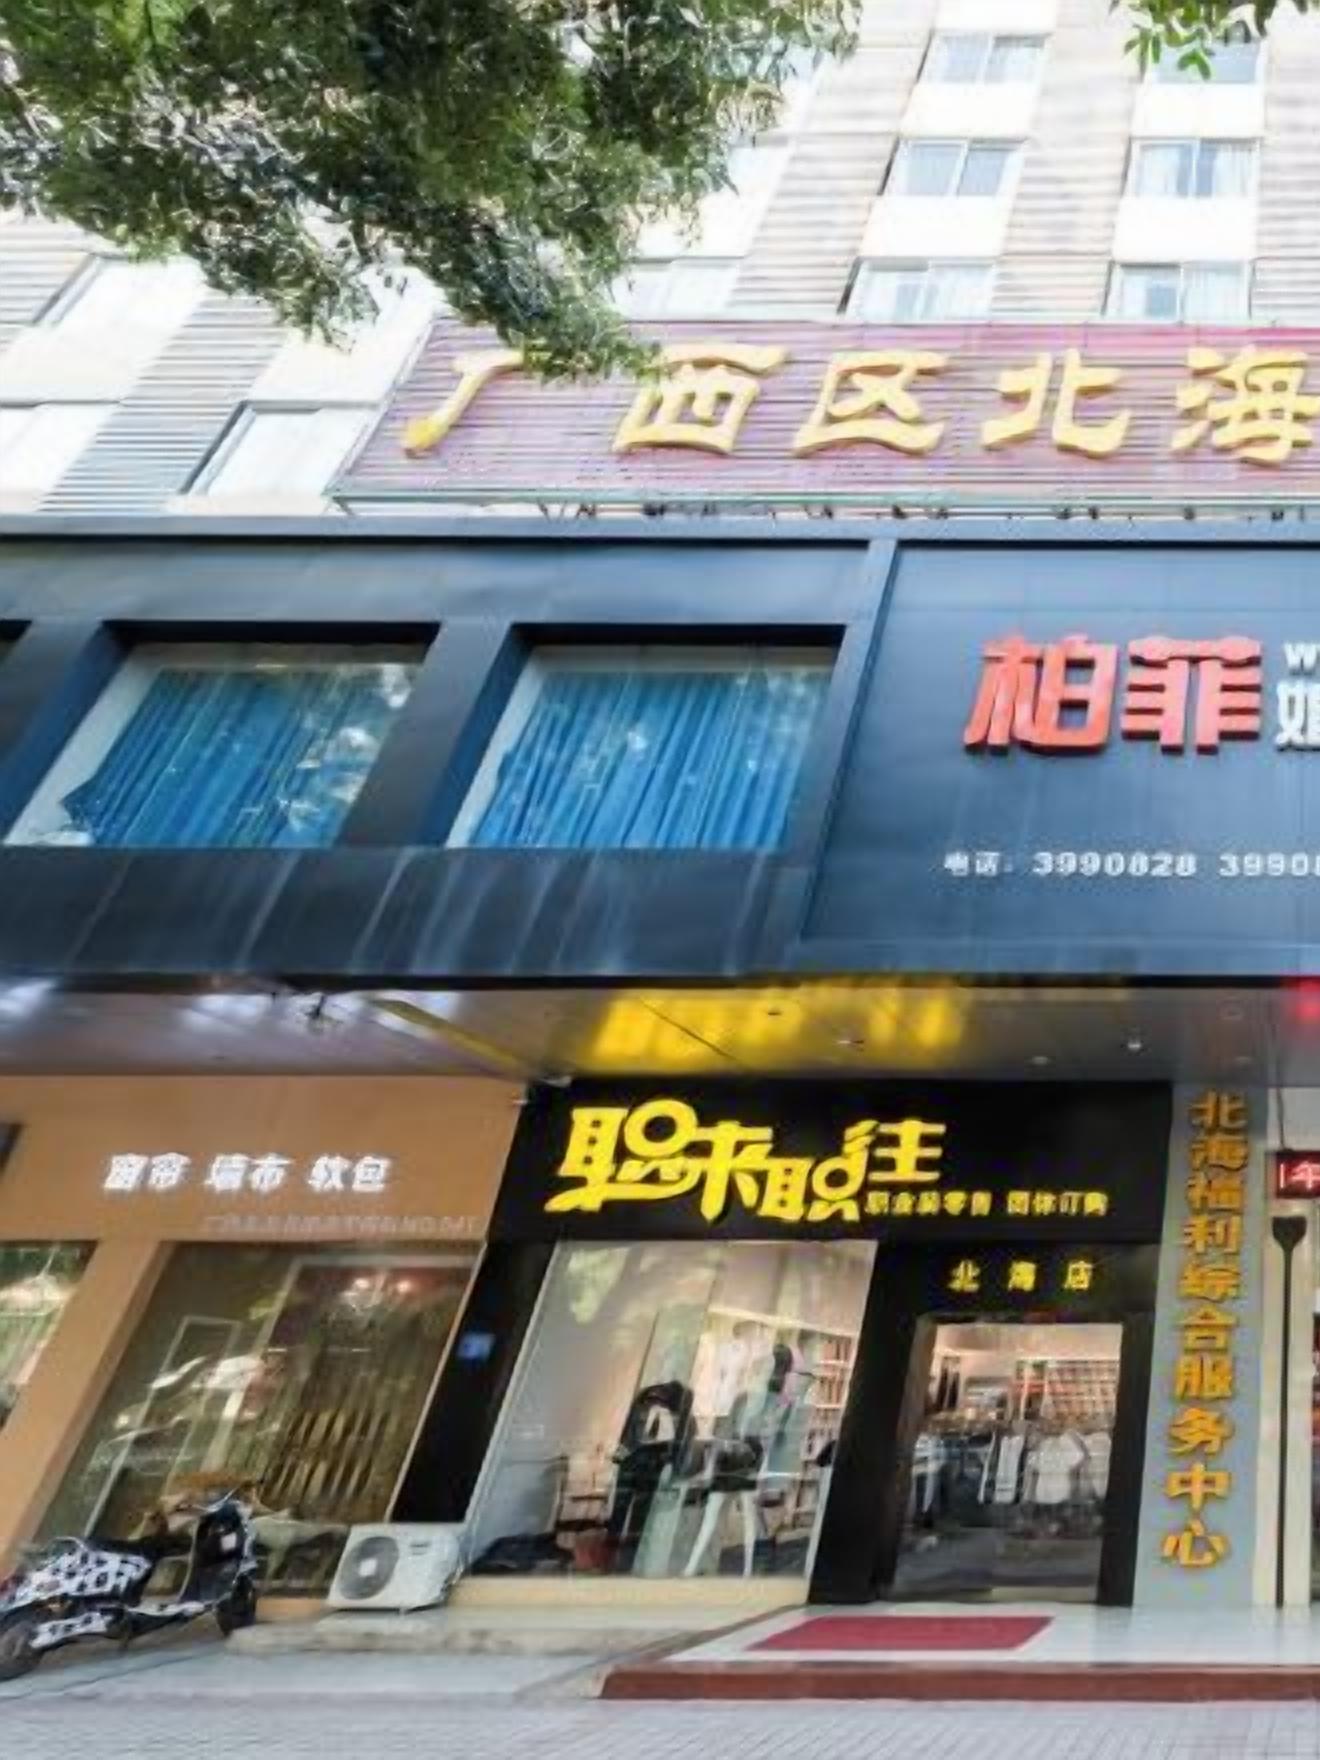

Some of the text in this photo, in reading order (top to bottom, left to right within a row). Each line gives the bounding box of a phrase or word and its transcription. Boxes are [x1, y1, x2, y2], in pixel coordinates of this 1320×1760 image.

[963, 633, 1262, 754] 柏菲
[307, 1154, 392, 1192] 软包
[948, 1259, 1094, 1293] 北海店
[1162, 1090, 1248, 1569] 北海福利综合服务中心
